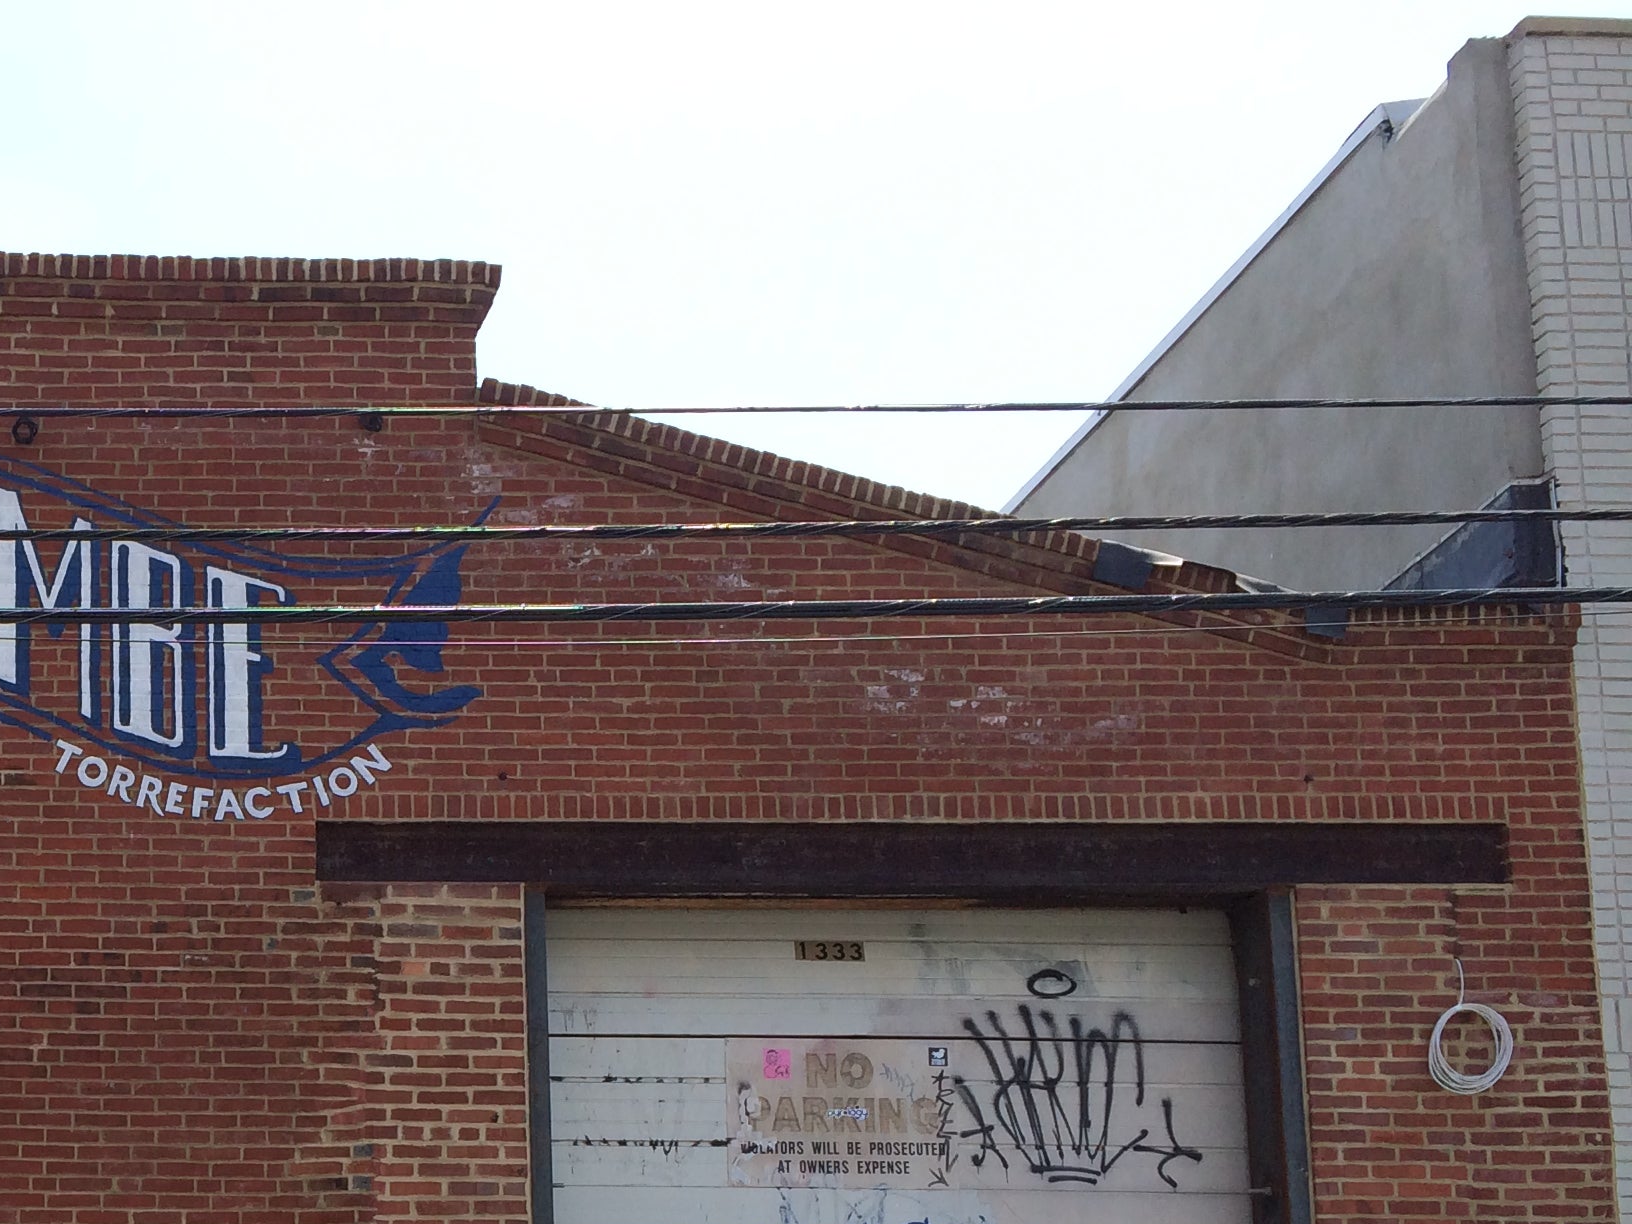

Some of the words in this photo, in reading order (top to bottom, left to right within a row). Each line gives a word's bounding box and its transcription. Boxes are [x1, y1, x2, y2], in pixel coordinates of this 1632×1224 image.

[56, 738, 393, 821] TORREFACTION
[799, 941, 863, 961] 1333
[805, 1052, 874, 1089] NO
[812, 1141, 839, 1155] WILL
[847, 1142, 861, 1155] BE
[778, 1160, 790, 1174] AT
[800, 1160, 849, 1174] OWNERS
[857, 1161, 910, 1175] EXPENSE
